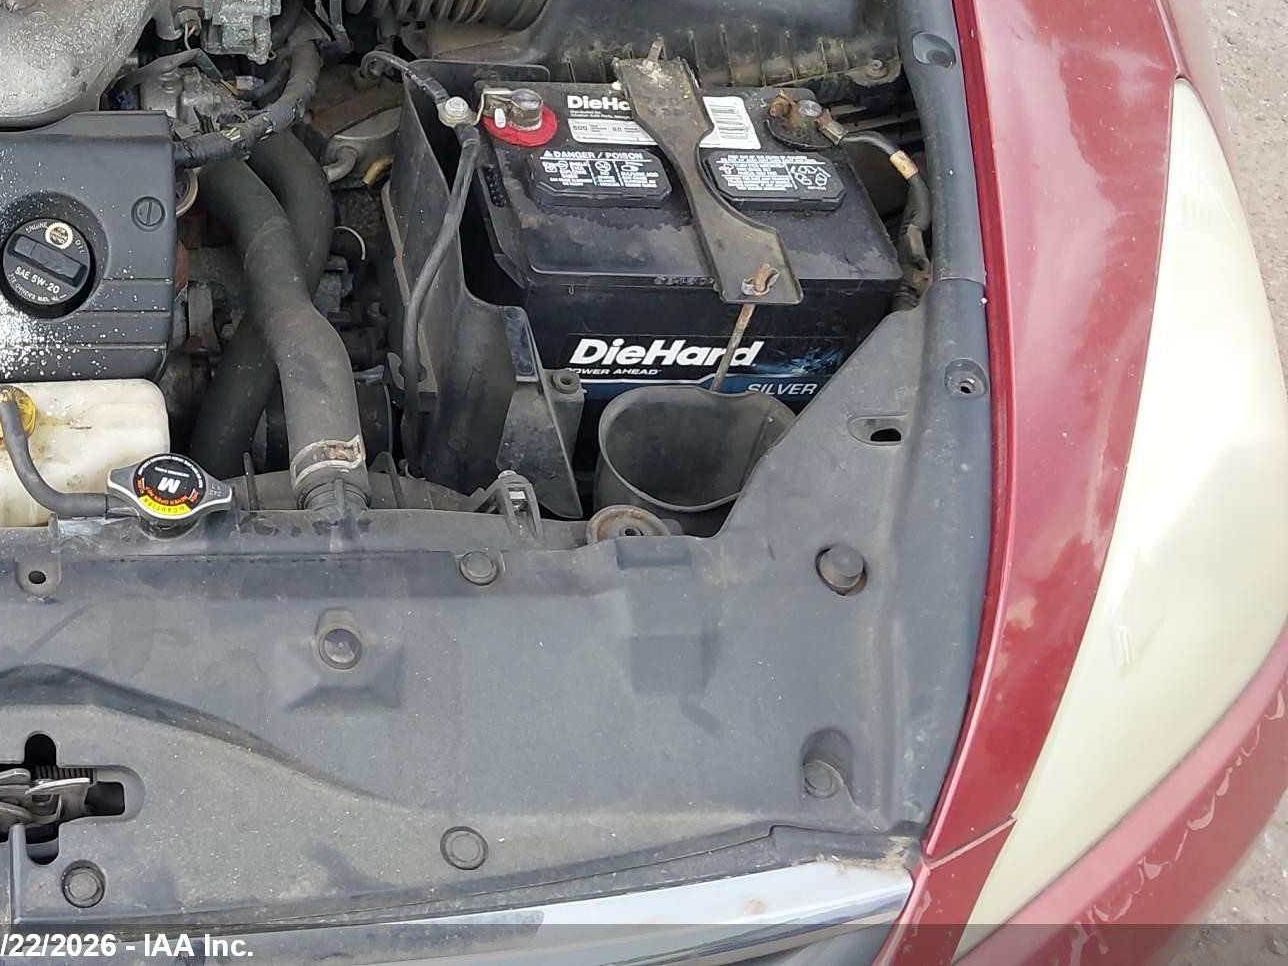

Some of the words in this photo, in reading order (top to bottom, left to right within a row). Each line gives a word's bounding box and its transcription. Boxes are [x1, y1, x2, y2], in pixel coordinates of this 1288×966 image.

[553, 150, 595, 159] DANGER
[605, 151, 644, 160] POISON
[74, 239, 86, 255] OIL
[15, 266, 31, 280] SAE
[569, 338, 765, 367] DieHard
[747, 383, 818, 395] SILVER
